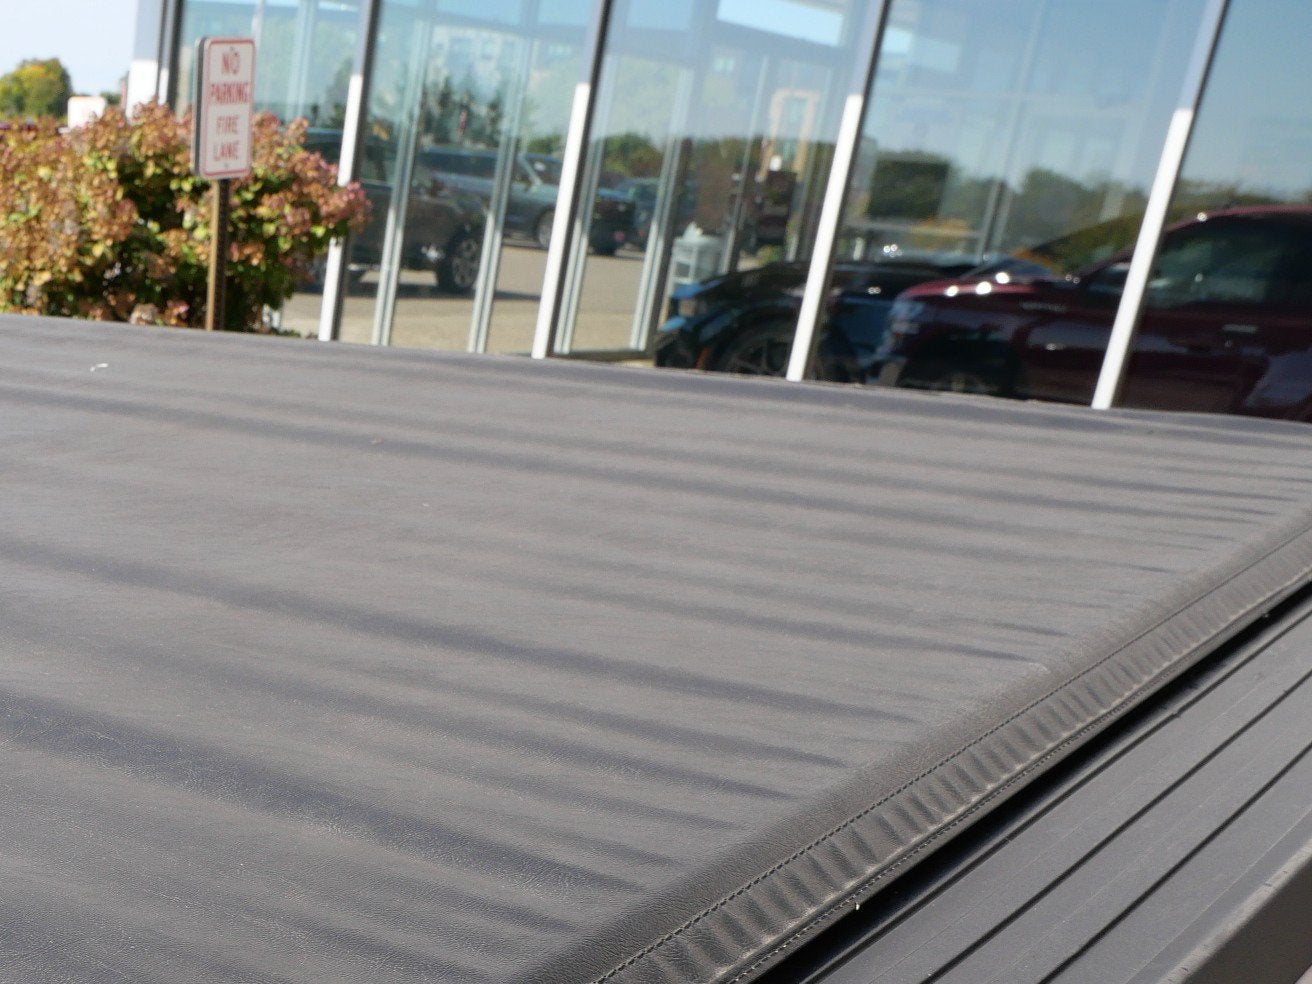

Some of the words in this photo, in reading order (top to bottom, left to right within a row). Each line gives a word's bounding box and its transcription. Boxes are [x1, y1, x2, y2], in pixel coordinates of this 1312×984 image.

[221, 52, 240, 74] NO
[210, 81, 249, 104] PARKING
[216, 114, 239, 136] FIRE
[213, 140, 240, 162] LANE
